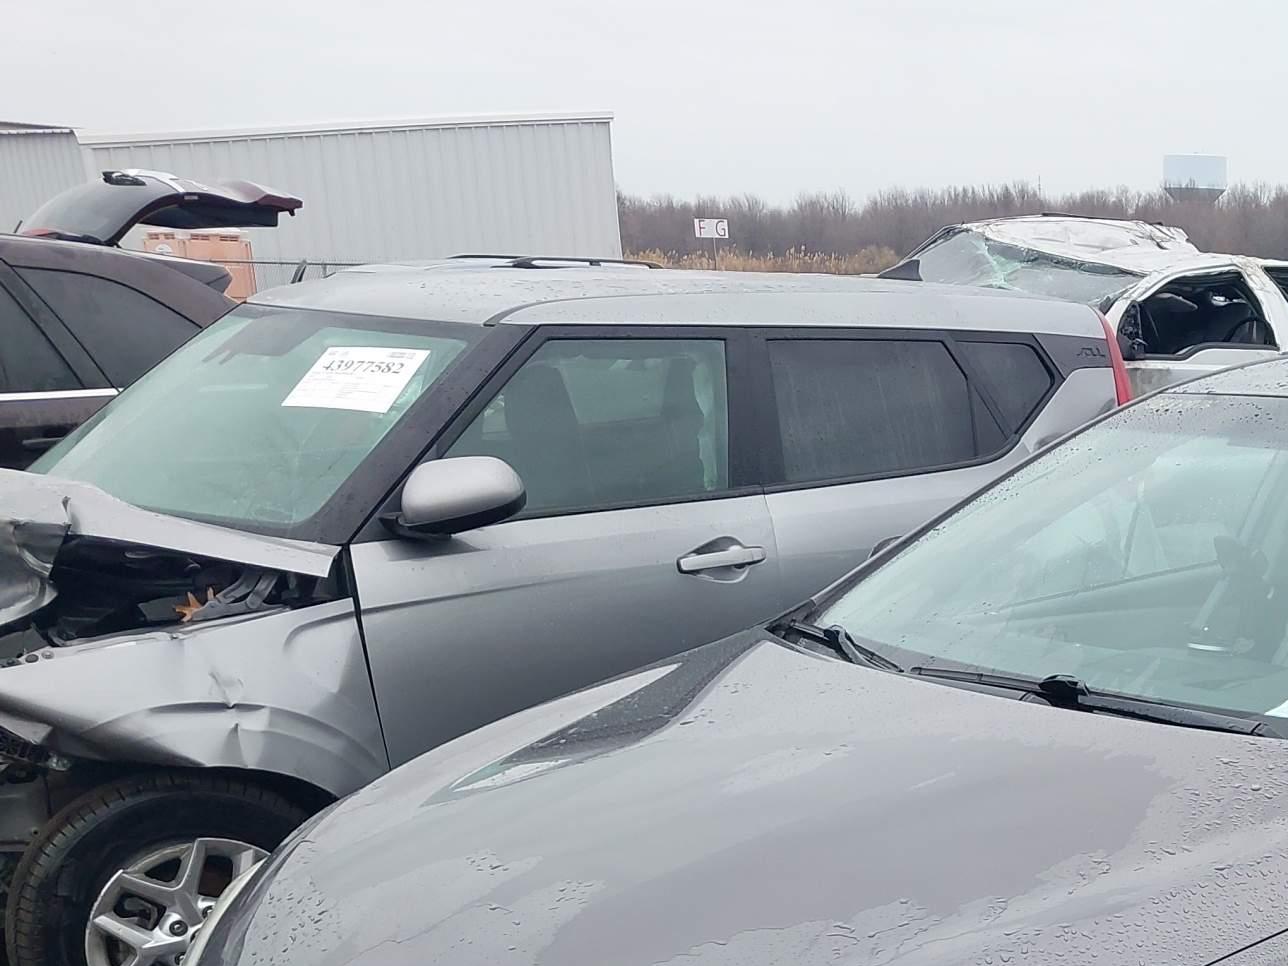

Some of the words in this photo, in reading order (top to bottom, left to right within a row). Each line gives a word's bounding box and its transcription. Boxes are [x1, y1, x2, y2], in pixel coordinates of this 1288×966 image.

[699, 220, 706, 236] F
[716, 220, 726, 236] G
[323, 360, 404, 374] 43977582
